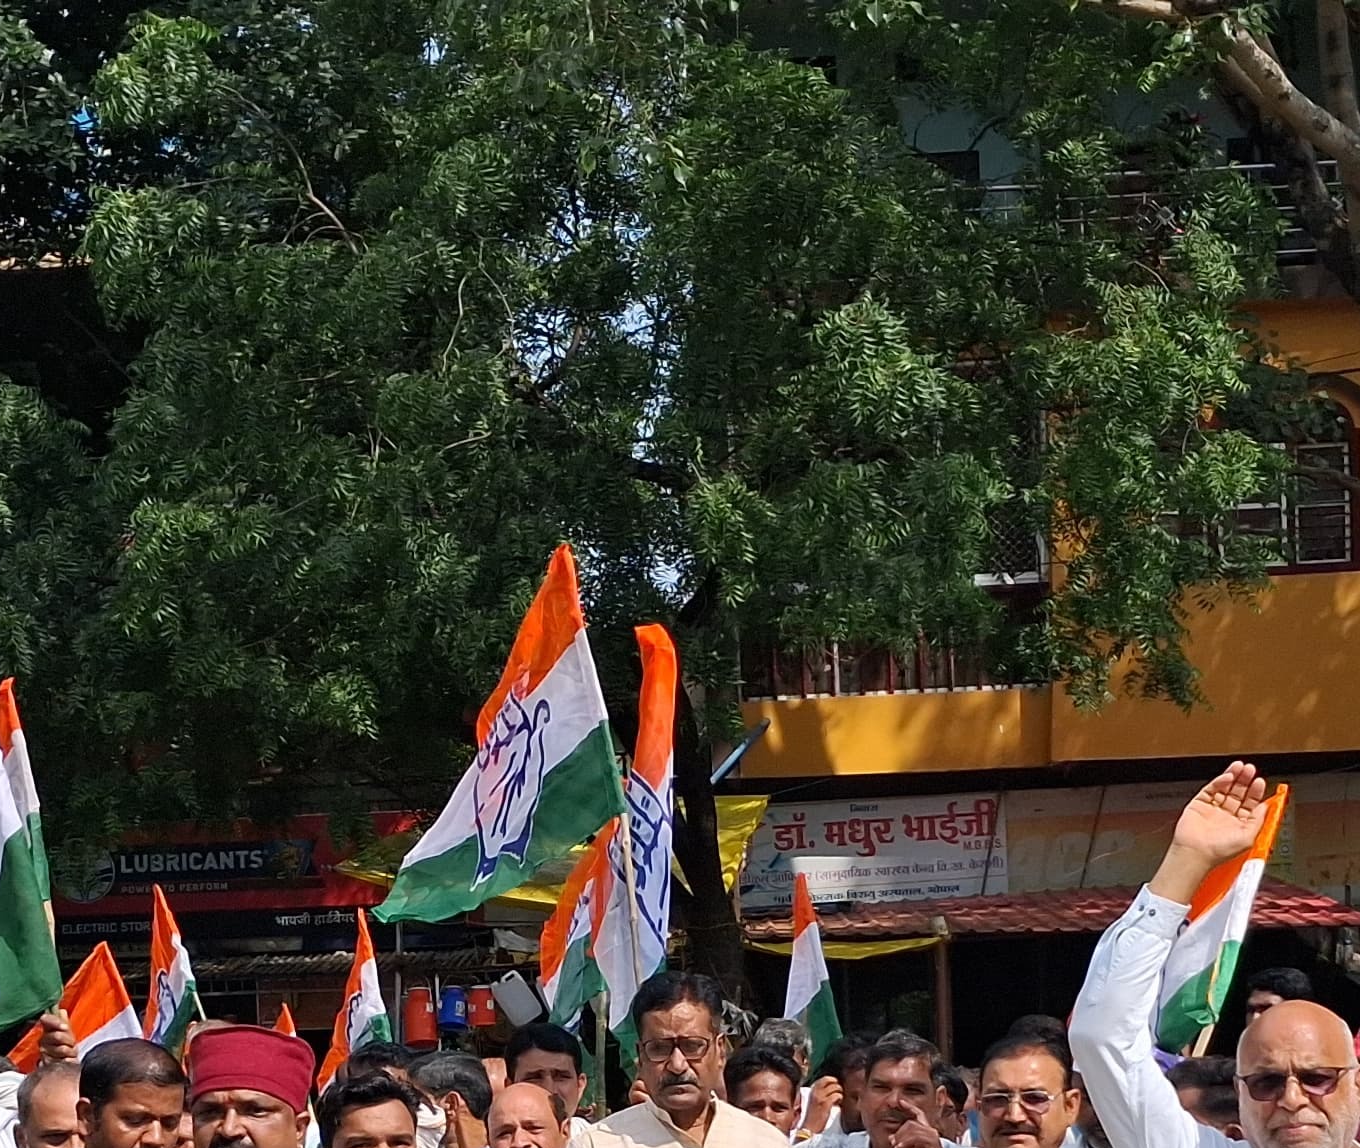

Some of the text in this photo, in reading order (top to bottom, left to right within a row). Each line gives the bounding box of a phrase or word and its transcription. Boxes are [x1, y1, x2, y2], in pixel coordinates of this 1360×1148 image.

[772, 798, 997, 857] डॉ. मधुर भाईजी
[120, 849, 264, 874] LUBRICANTS
[62, 920, 152, 935] ELECTRIC STOR
